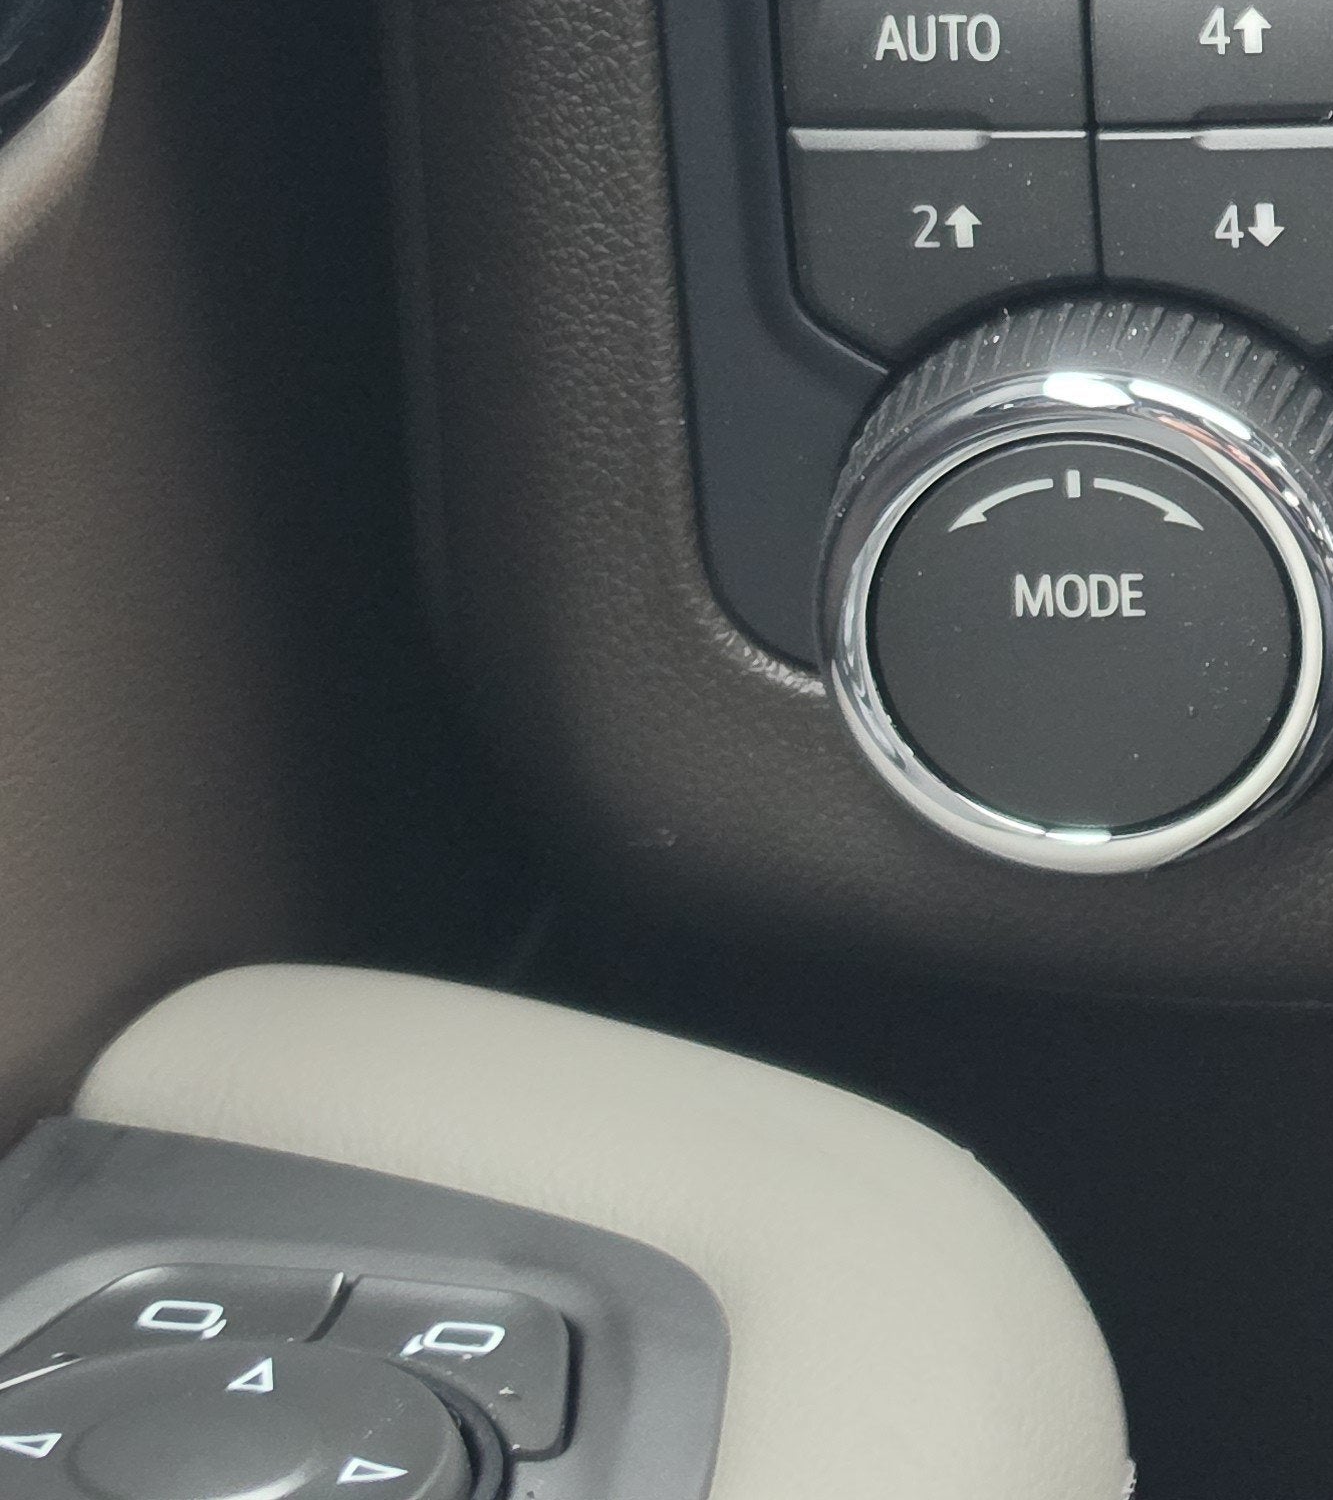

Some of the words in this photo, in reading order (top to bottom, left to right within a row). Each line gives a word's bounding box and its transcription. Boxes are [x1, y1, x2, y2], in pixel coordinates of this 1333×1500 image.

[873, 13, 1001, 63] AUTO
[1198, 7, 1231, 56] 4
[911, 204, 940, 249] 2
[1213, 203, 1244, 249] 4
[1013, 572, 1147, 618] MODE
